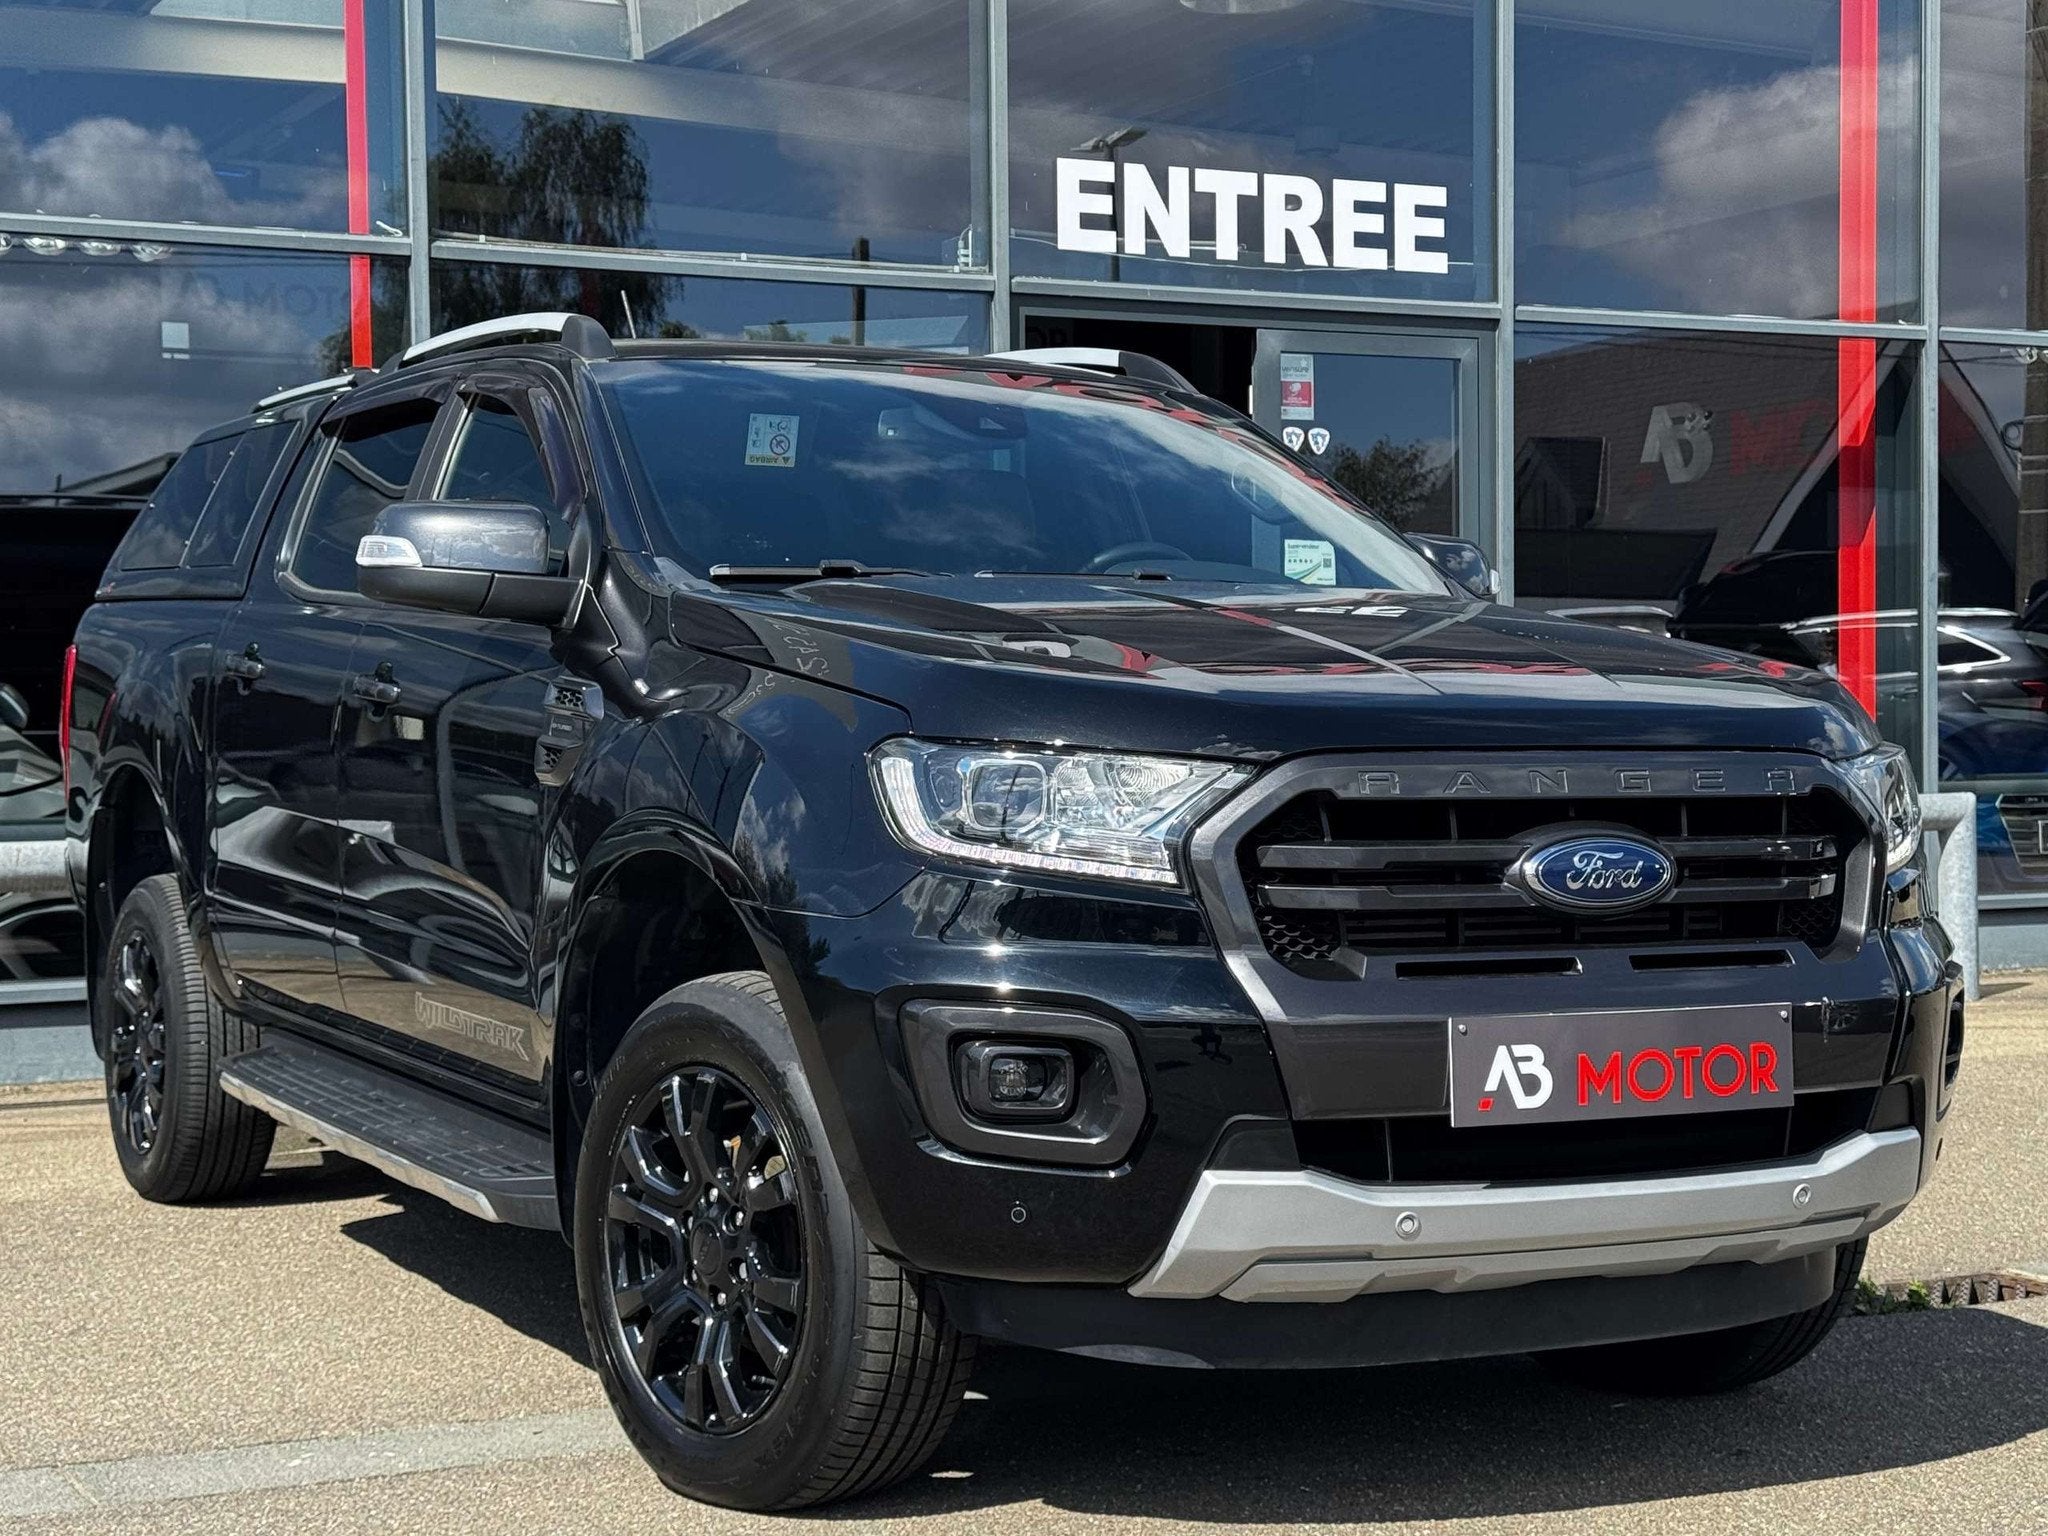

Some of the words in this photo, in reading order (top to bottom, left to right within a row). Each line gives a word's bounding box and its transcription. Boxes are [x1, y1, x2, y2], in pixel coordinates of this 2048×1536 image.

[1057, 158, 1448, 274] ENTREE
[1358, 769, 1796, 794] RANGER
[1566, 850, 1643, 890] Ford
[415, 991, 529, 1062] WILDTRAK
[1478, 1043, 1553, 1111] AB
[1577, 1042, 1779, 1106] MOTOR
